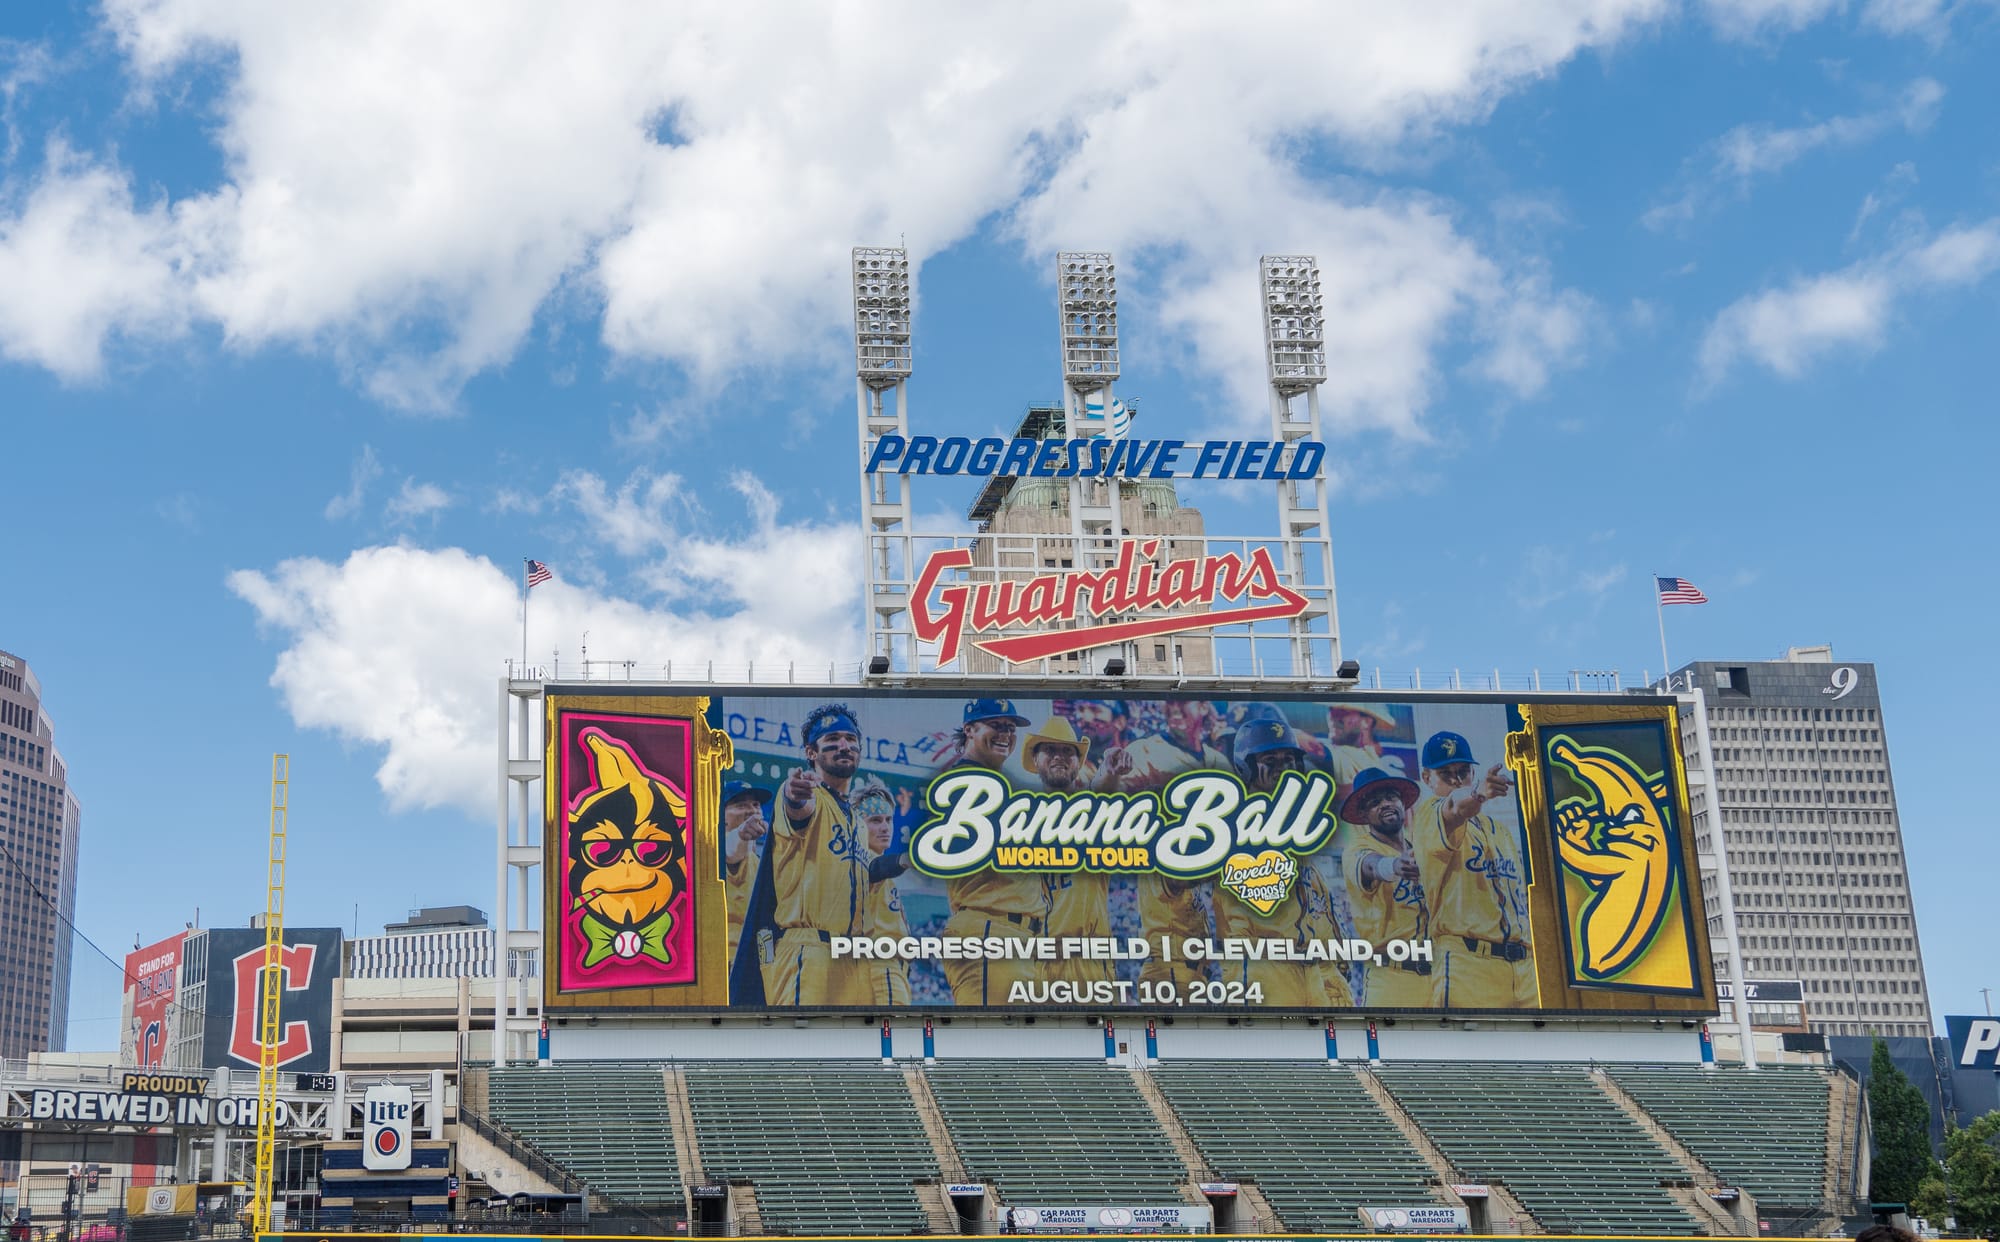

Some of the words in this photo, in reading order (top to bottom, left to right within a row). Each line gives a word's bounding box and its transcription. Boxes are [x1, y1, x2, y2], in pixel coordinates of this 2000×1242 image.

[865, 435, 1185, 479] PROGRESSIVE
[1192, 440, 1327, 480] FIELD
[908, 537, 1311, 669] Guardians
[1822, 686, 1837, 695] the
[1831, 667, 1858, 701] 9
[917, 774, 1162, 869] Banana
[1155, 772, 1330, 871] Ball
[996, 846, 1080, 867] WORLD
[1085, 847, 1150, 867] TOUR
[1223, 859, 1273, 885] Loved
[1274, 857, 1296, 880] by
[1238, 884, 1280, 901] Zappos
[138, 957, 161, 977] STAND
[160, 951, 175, 967] FOR
[831, 936, 1060, 960] PROGRESSIVE
[1063, 937, 1151, 960] FIELD
[1183, 937, 1383, 966] CLEVELAND,
[1385, 939, 1433, 962] OH
[137, 979, 152, 1001] THE
[153, 969, 174, 994] LAND
[1007, 980, 1135, 1004] AUGUST
[1139, 981, 1184, 1007] 10,
[1188, 981, 1264, 1005] 2024
[228, 943, 318, 1070] C
[1960, 1020, 2000, 1066] P
[124, 1075, 209, 1094] PROUDLY
[311, 1077, 335, 1090] 1:43
[32, 1091, 170, 1124] BREWED
[176, 1096, 210, 1126] IN
[368, 1101, 409, 1126] Lite
[1462, 1186, 1487, 1194] brembo
[1040, 1209, 1057, 1217] CAR
[1059, 1209, 1087, 1217] PARTS
[1133, 1209, 1150, 1217] CAR
[1152, 1209, 1180, 1217] PARTS
[1409, 1209, 1427, 1217] CAR
[1428, 1209, 1455, 1217] PARTS
